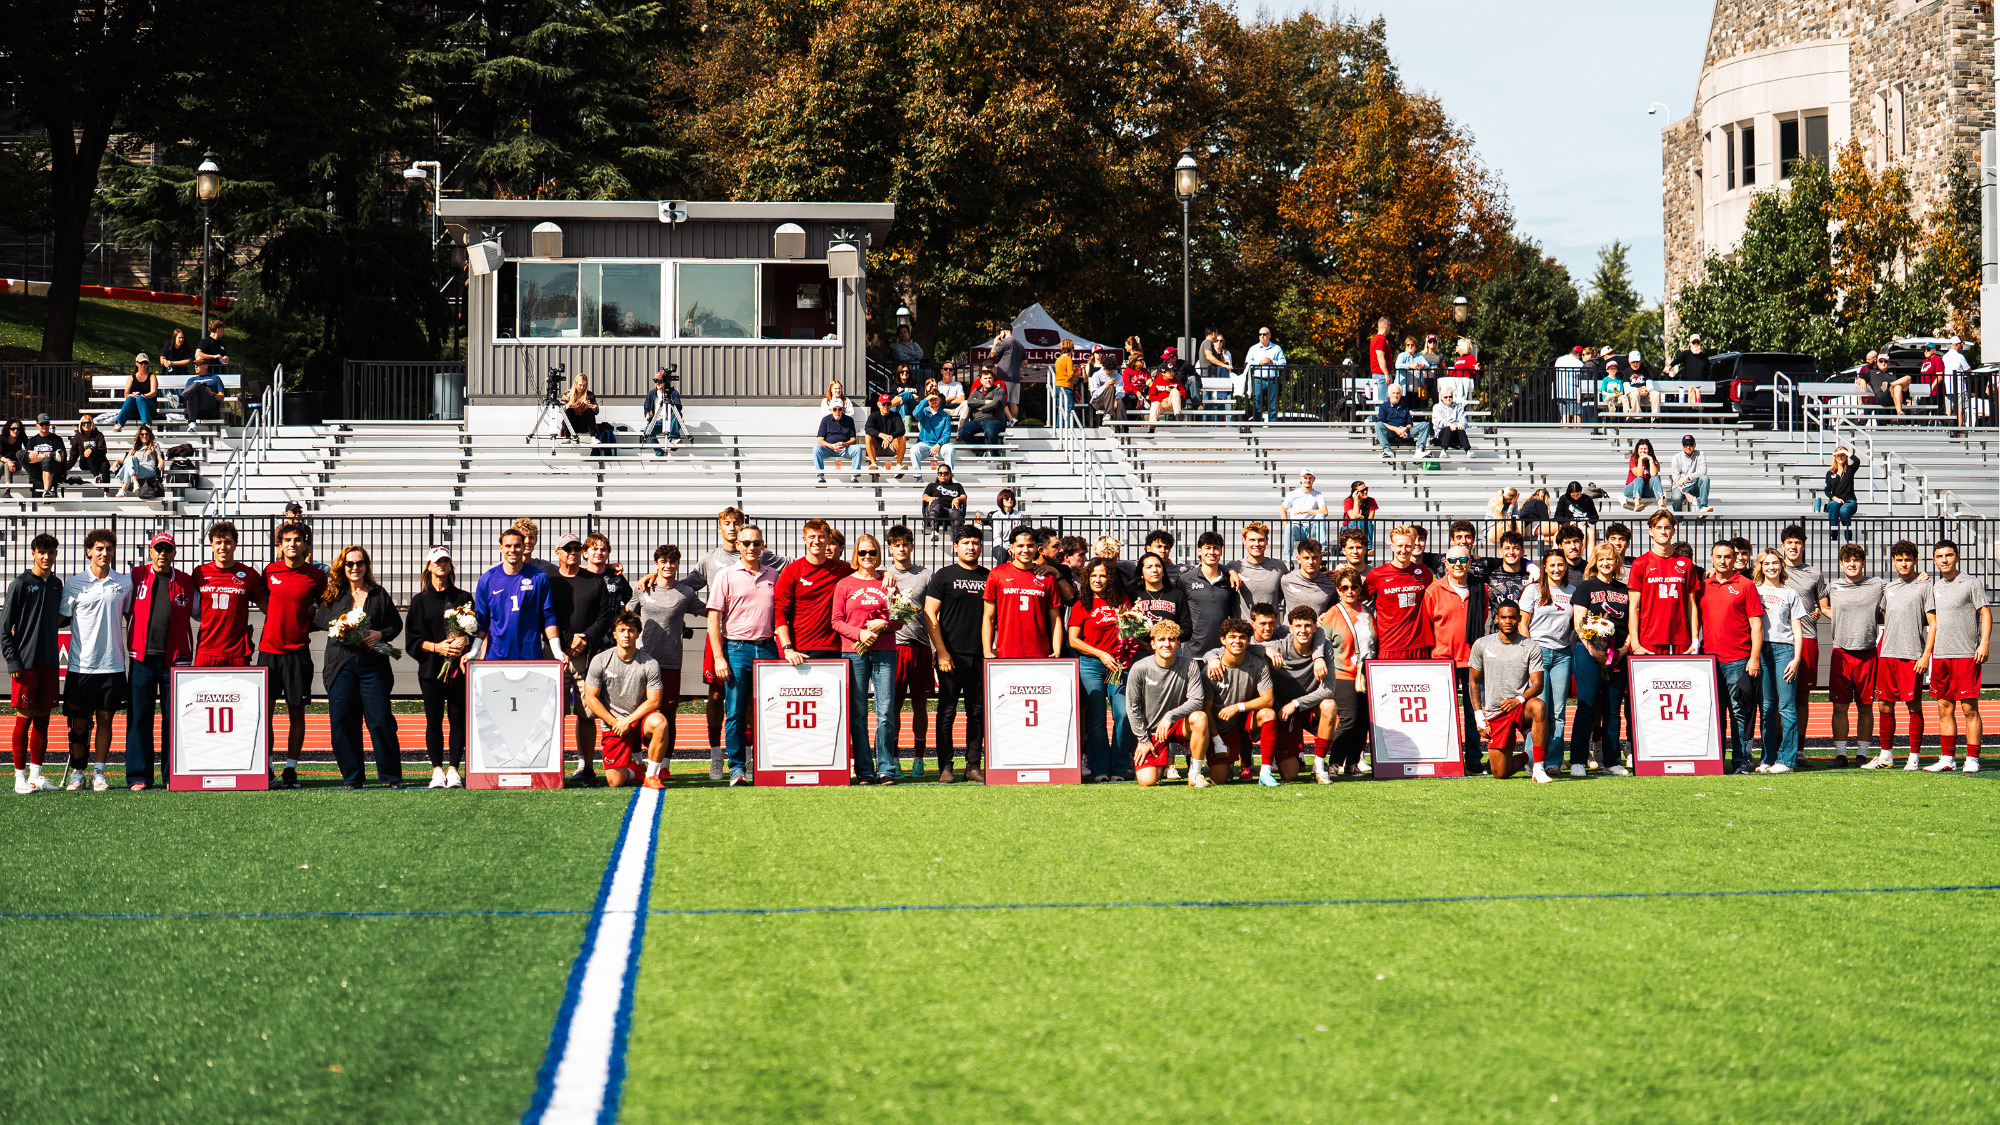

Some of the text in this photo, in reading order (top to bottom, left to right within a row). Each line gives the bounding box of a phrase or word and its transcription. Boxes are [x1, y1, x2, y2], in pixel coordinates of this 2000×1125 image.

[1647, 576, 1664, 584] SAINT
[215, 587, 246, 595] JOSEPH'S
[1020, 588, 1045, 597] JOSEPH'S
[1383, 587, 1401, 595] SAINT
[1658, 583, 1679, 599] 24
[211, 593, 230, 610] 10
[510, 595, 520, 612] 1
[1019, 595, 1029, 611] 3
[1150, 599, 1176, 614] JOSEPH'S
[1397, 592, 1416, 609] 22
[779, 687, 823, 697] HAWKS
[1009, 686, 1051, 695] HAWKS
[1391, 684, 1431, 692] HAWKS
[1652, 680, 1692, 689] HAWKS
[195, 694, 241, 703] HAWKS
[510, 697, 518, 712] 1
[1025, 699, 1038, 727] 3
[1399, 696, 1428, 723] 22
[1659, 693, 1690, 721] 24
[205, 707, 234, 734] 10
[786, 701, 817, 729] 25
